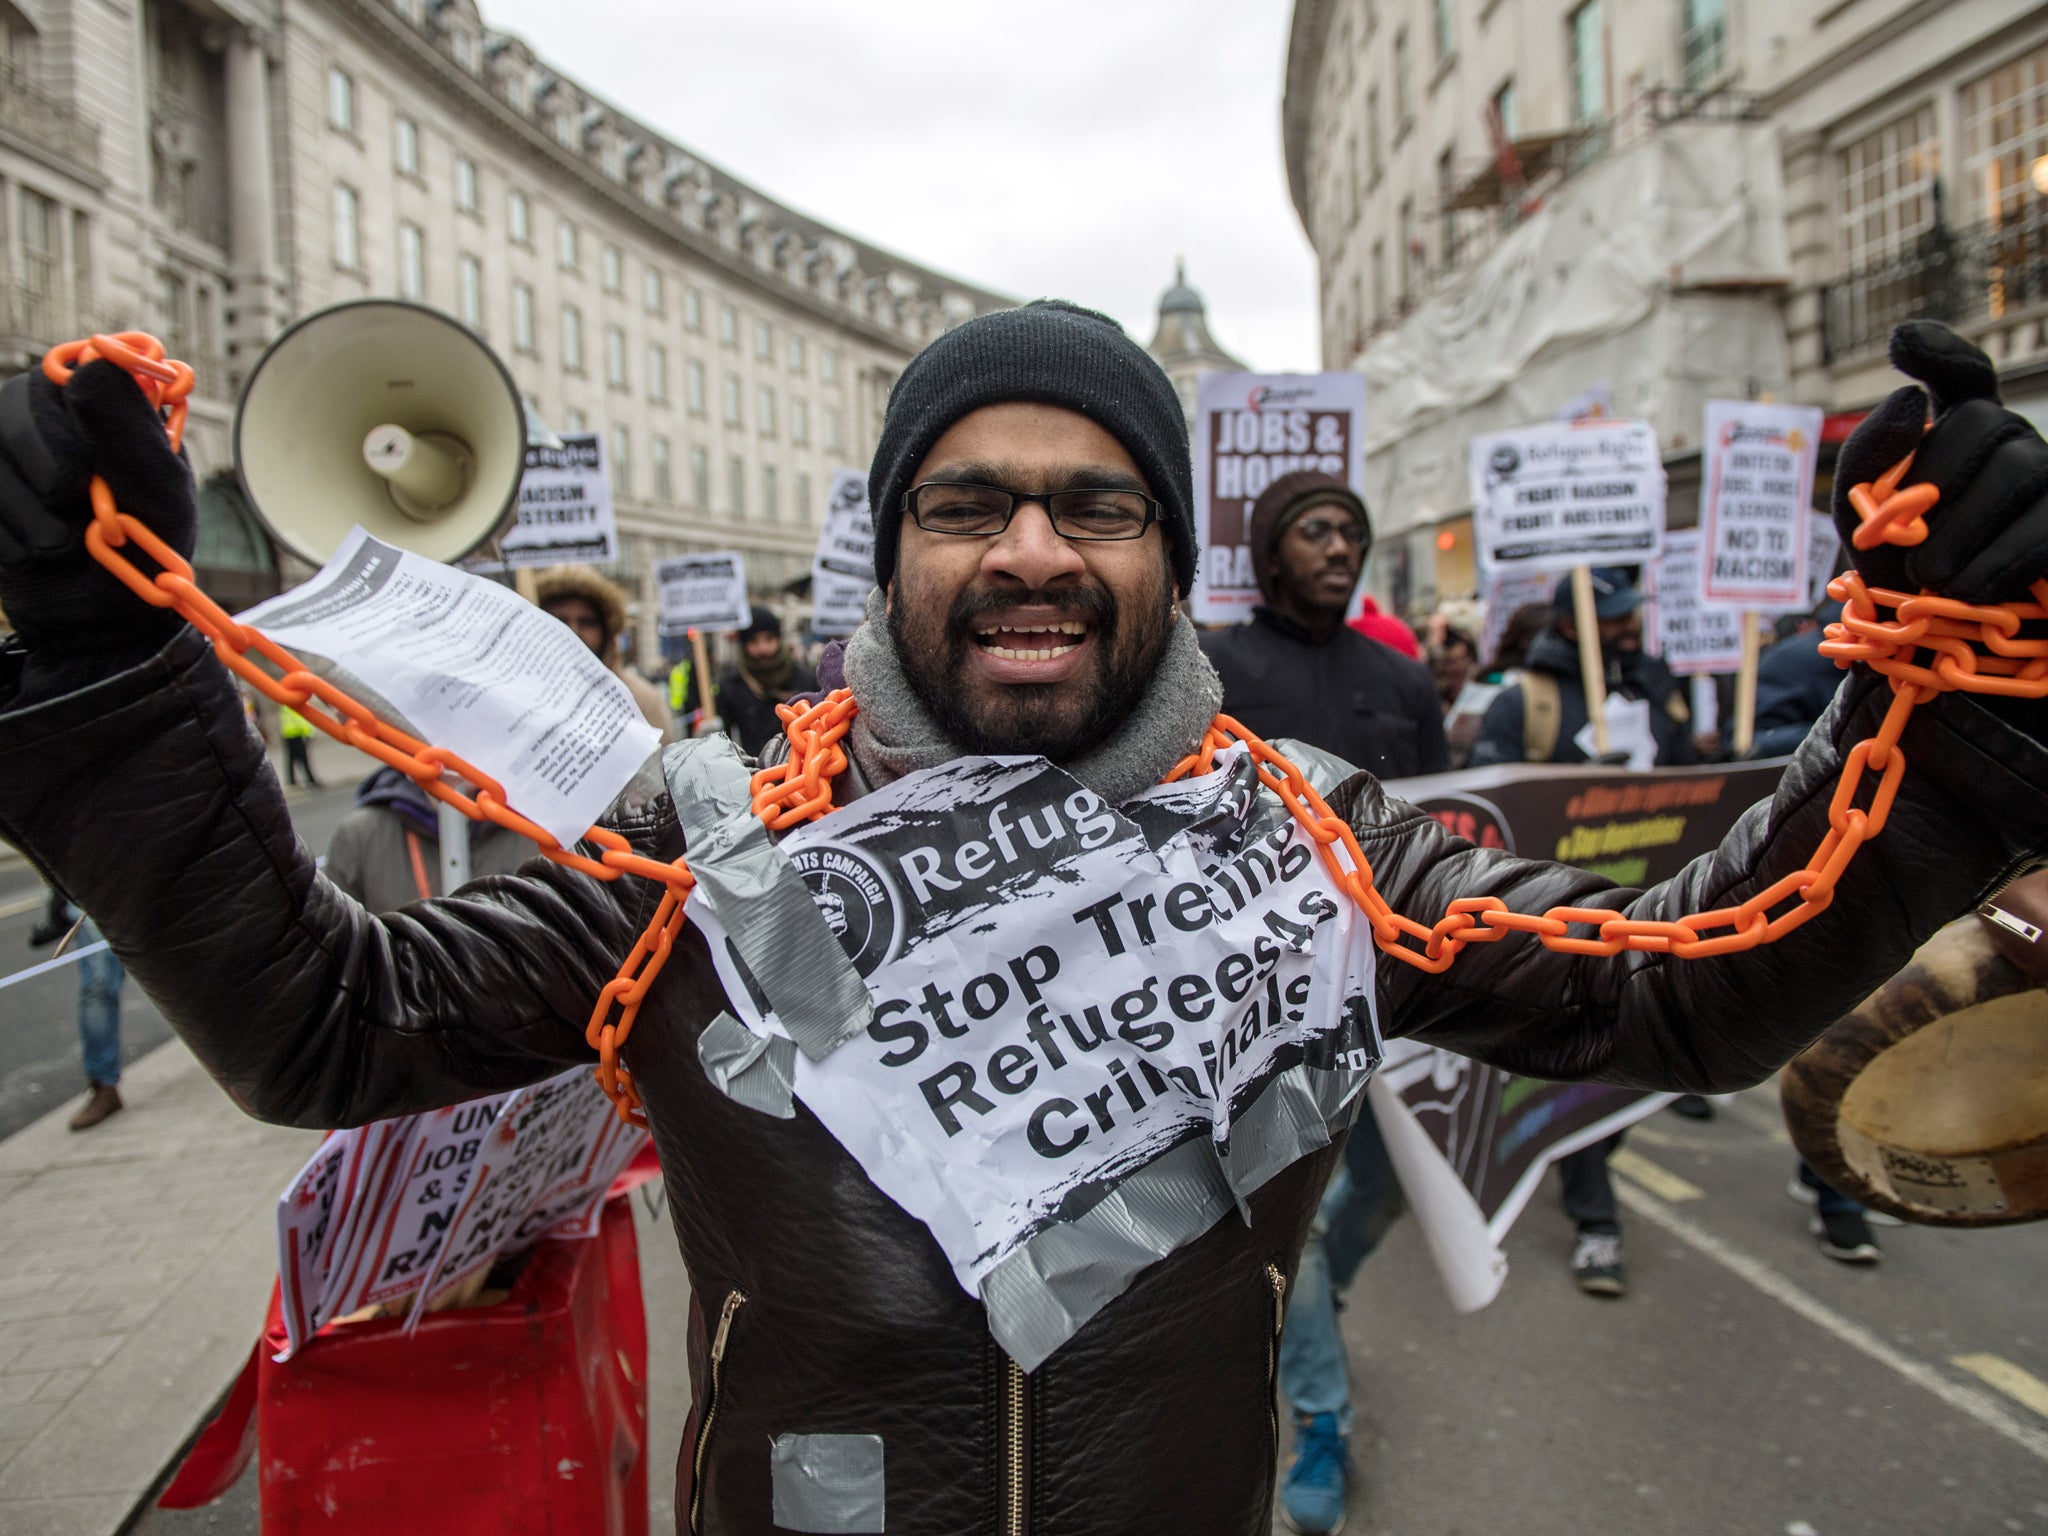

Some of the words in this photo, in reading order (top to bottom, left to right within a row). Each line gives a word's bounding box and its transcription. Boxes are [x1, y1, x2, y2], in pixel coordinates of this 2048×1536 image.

[1217, 412, 1311, 453] JOBS
[1313, 415, 1345, 453] &
[522, 485, 585, 503] ACISM
[1726, 528, 1759, 550] NO
[1766, 529, 1786, 550] TO
[1714, 558, 1796, 580] RACISM
[822, 852, 886, 906] CAMPAIGN
[866, 944, 1061, 1068] Stop
[917, 935, 1281, 1138] Refugees
[413, 1138, 481, 1179] JOB
[418, 1179, 443, 1205] &
